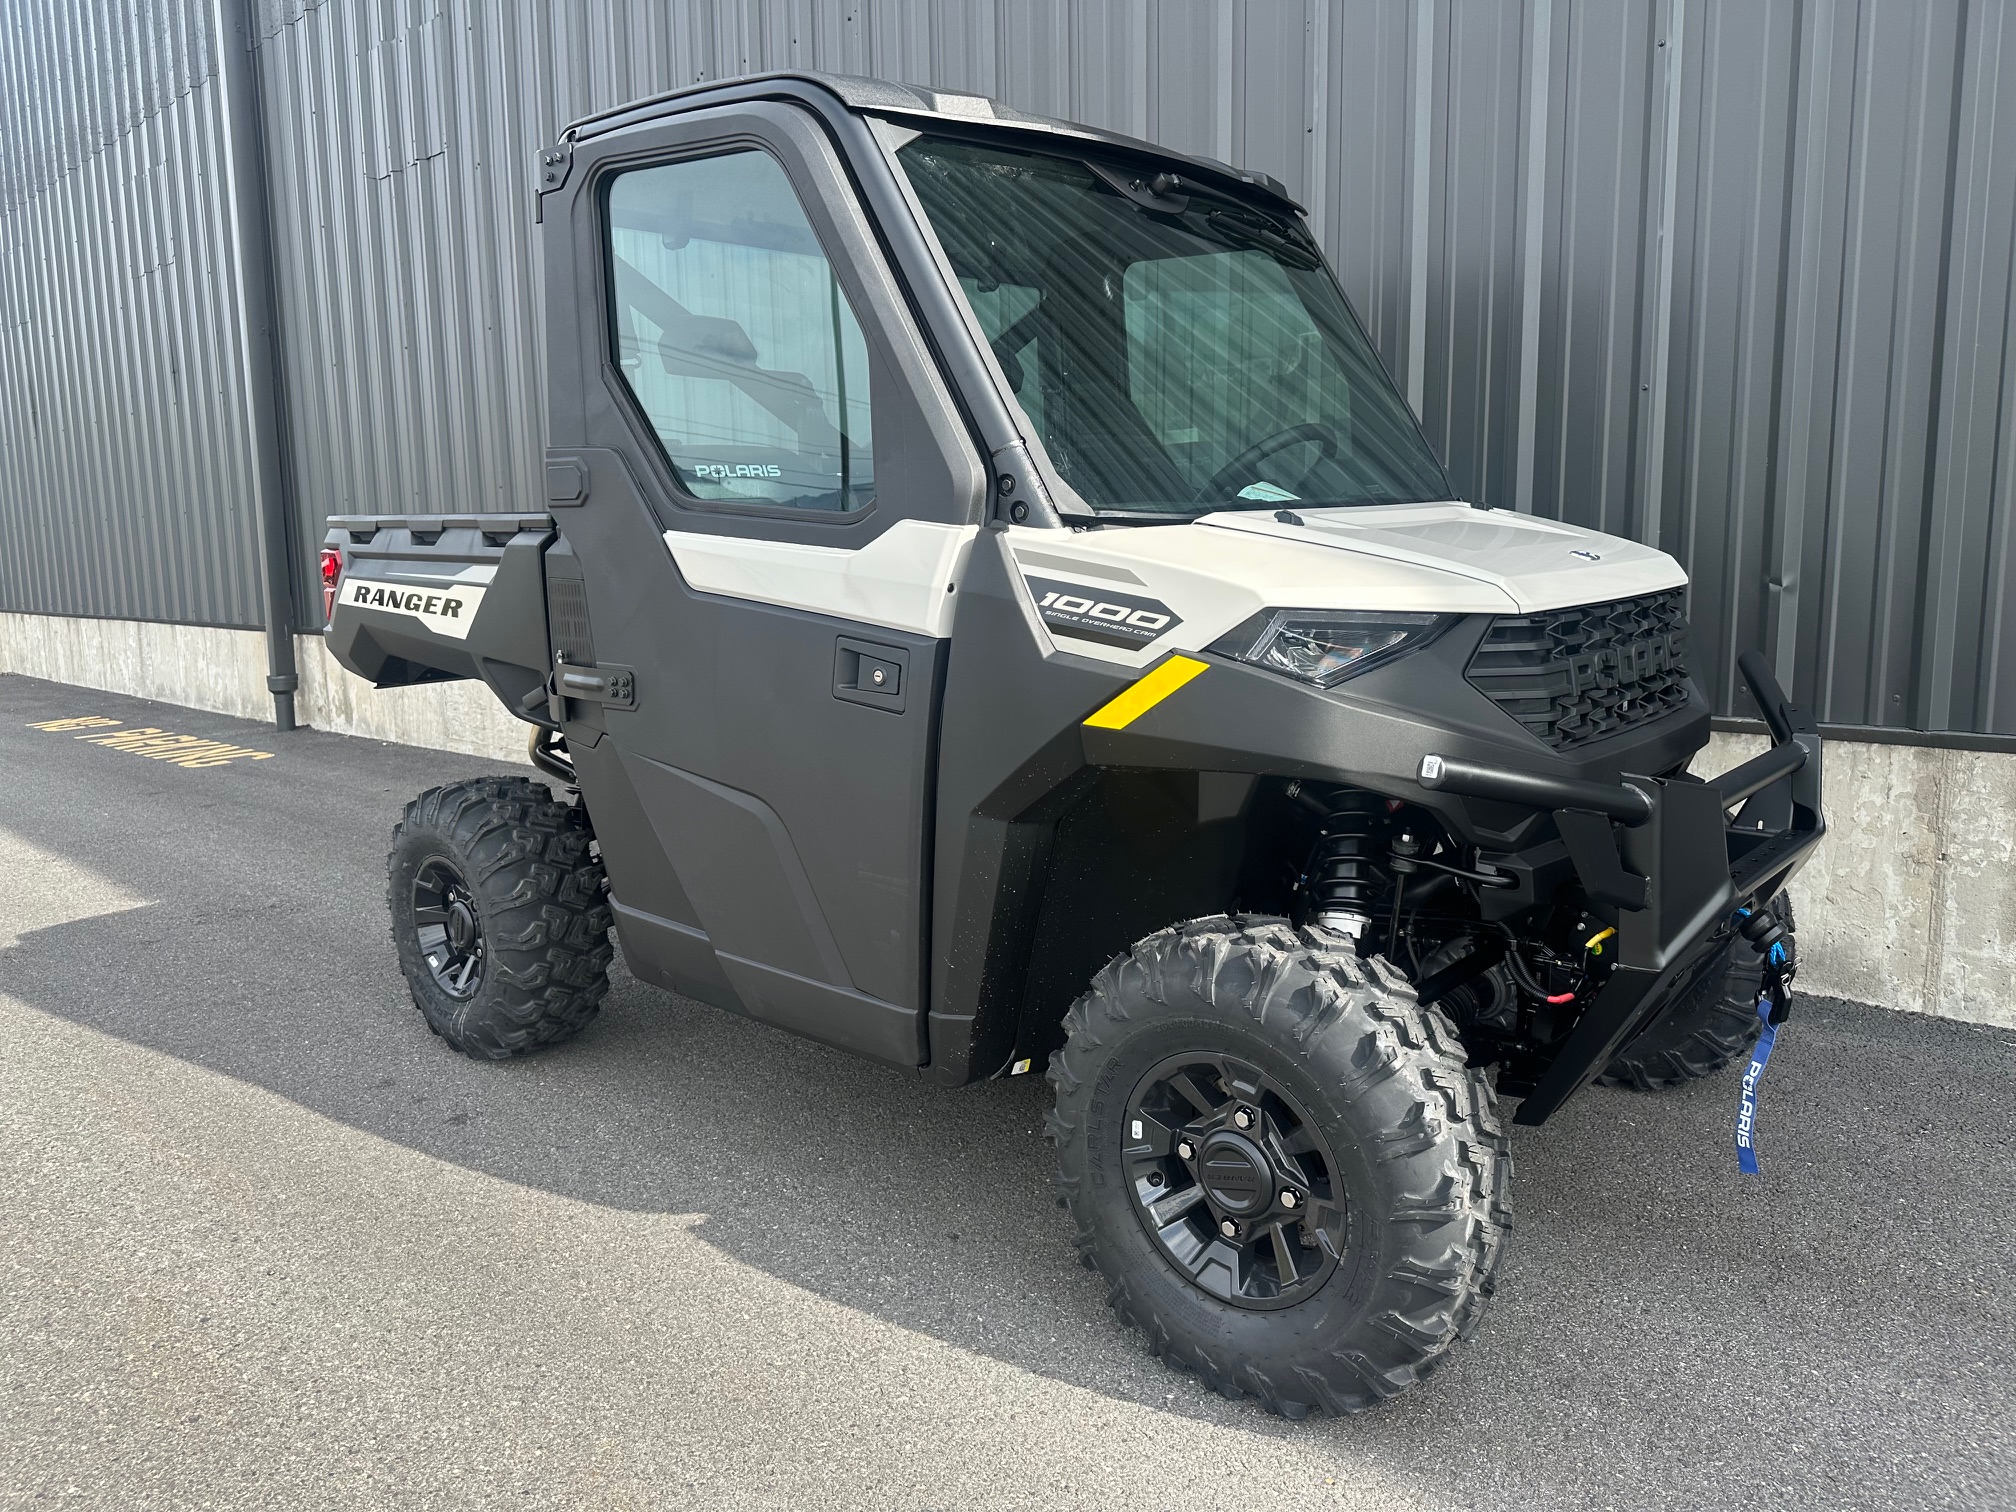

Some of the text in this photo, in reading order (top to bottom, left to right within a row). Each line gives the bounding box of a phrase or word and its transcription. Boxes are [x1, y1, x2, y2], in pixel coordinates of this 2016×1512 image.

[694, 464, 781, 477] POLARIS
[353, 585, 463, 618] RANGER
[1038, 591, 1171, 630] 1000
[1044, 610, 1157, 638] SINGLE OVERHEAD CAM
[1568, 629, 1689, 697] POLARIS
[1088, 1057, 1123, 1188] CARLSTAR
[1737, 1061, 1762, 1149] POLARIS
